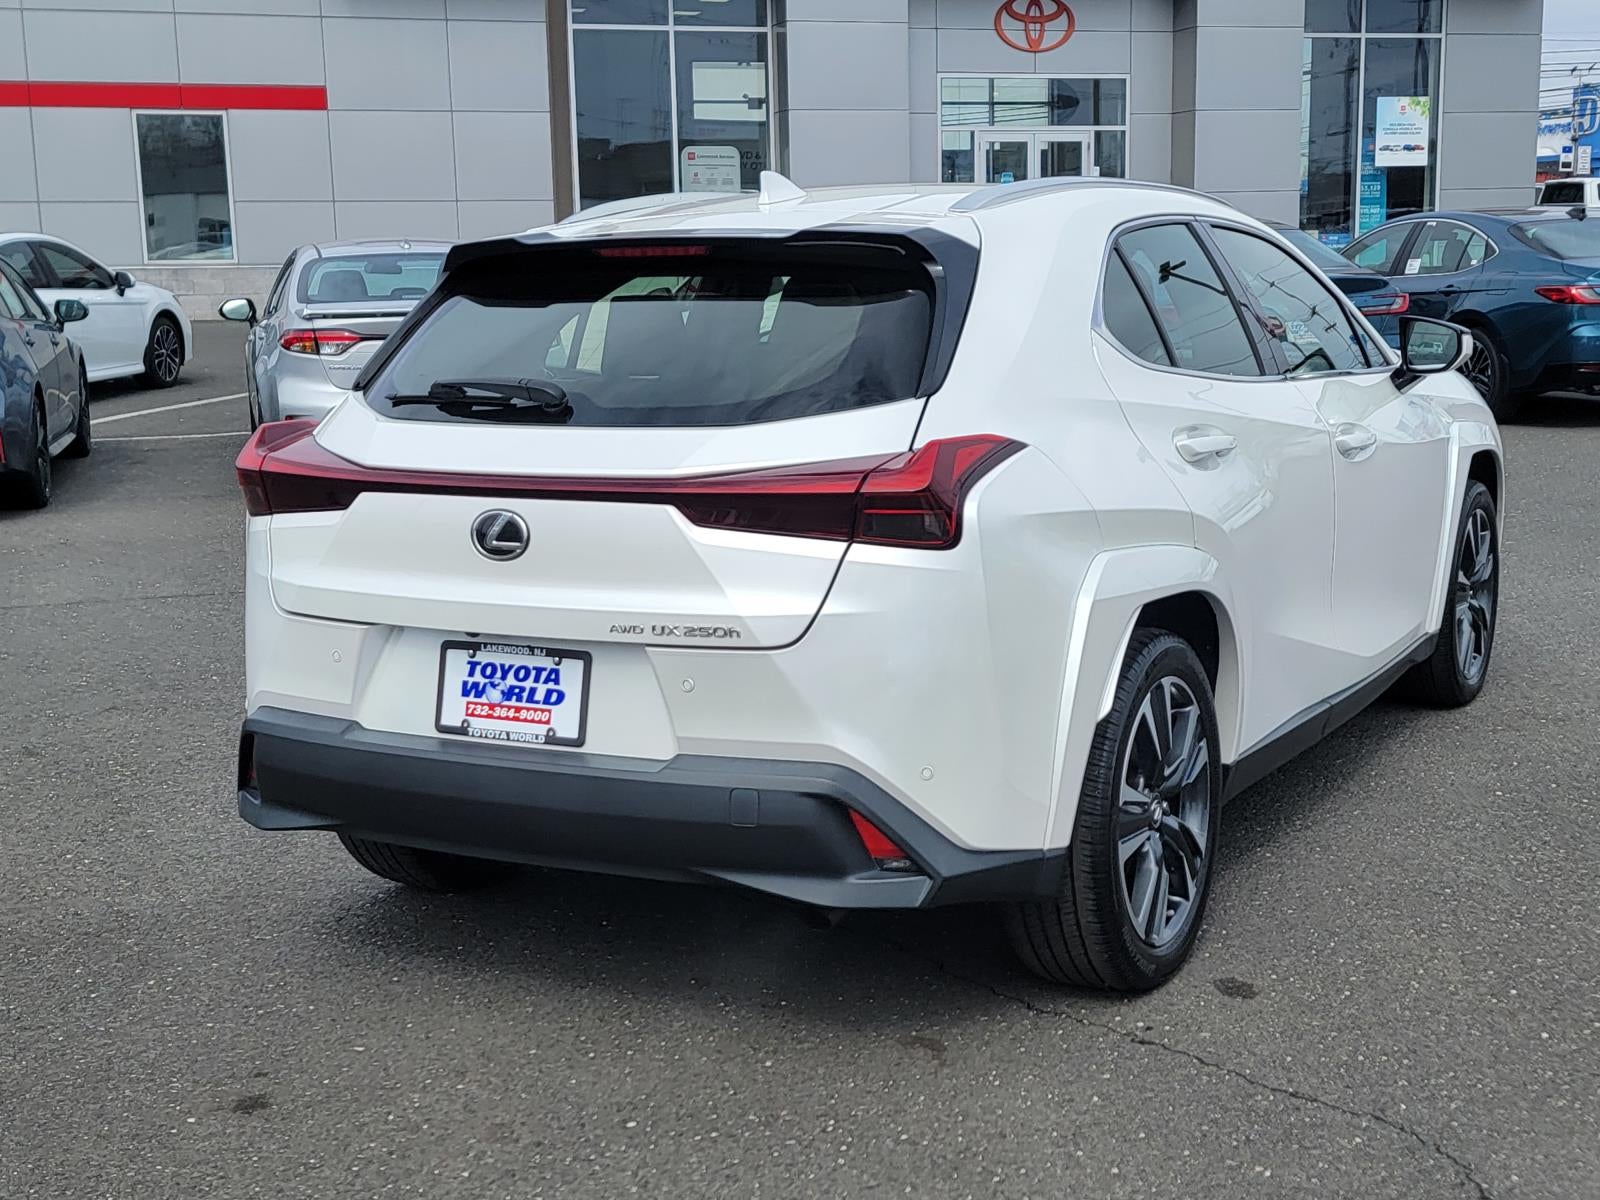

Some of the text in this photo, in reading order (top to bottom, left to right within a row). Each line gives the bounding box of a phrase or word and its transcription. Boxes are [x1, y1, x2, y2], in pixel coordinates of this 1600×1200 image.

[609, 624, 644, 635] AWD
[534, 647, 547, 657] NJ
[466, 660, 561, 686] TOYOTA
[467, 703, 550, 721] 732-364-9000
[467, 727, 546, 744] TOYOTA WORLD
